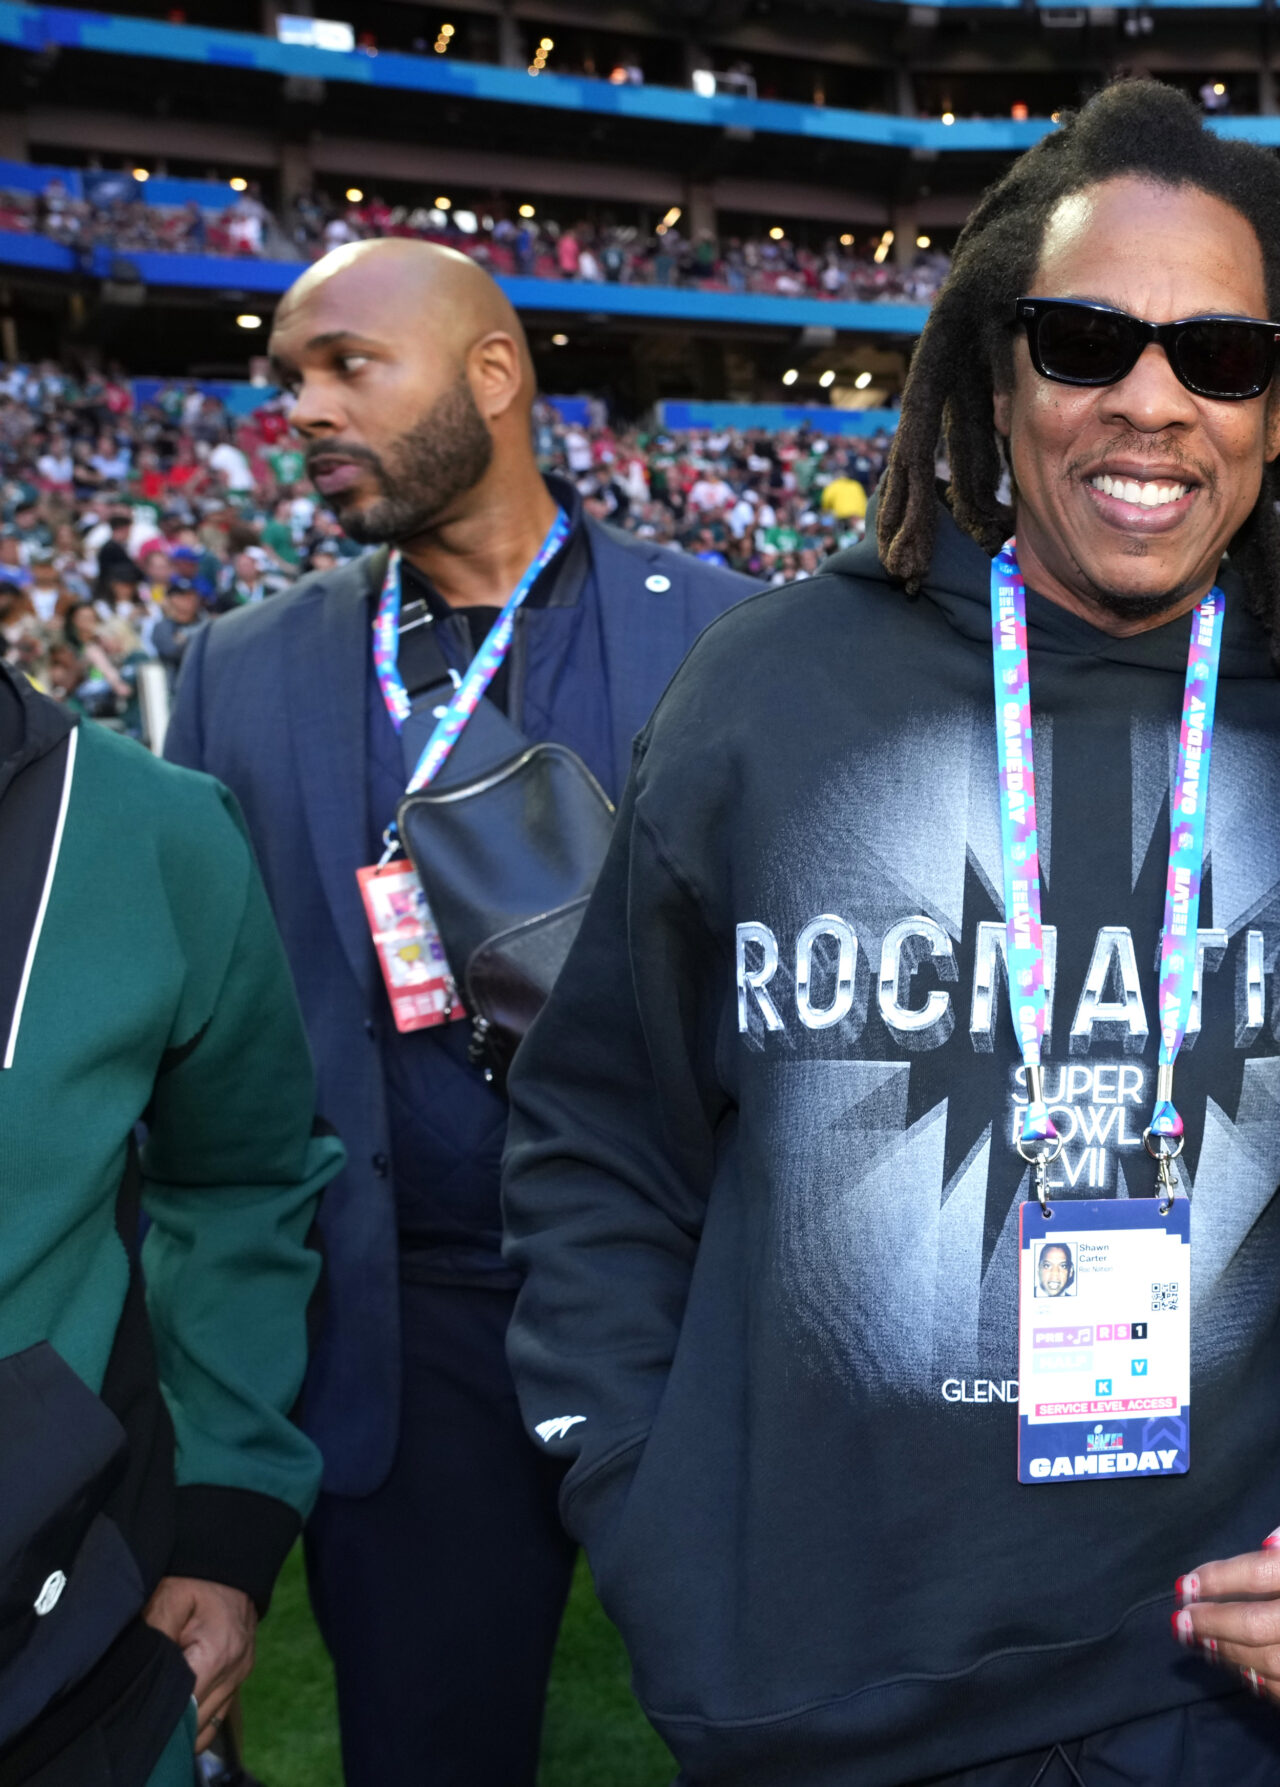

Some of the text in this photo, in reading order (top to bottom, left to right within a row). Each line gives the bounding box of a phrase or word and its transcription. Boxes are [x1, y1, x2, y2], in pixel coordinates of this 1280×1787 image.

[1003, 702, 1026, 825] GAMEDAY
[1181, 695, 1206, 815] GAMEDAY
[1011, 1065, 1143, 1104] SUPER
[1079, 1243, 1110, 1252] Shawn
[1079, 1254, 1107, 1263] Carter
[1134, 1361, 1145, 1374] V
[1098, 1381, 1109, 1394] K
[1039, 1397, 1174, 1416] SERVICE LEVEL ACCESS
[1029, 1449, 1179, 1478] GAMEDAY
